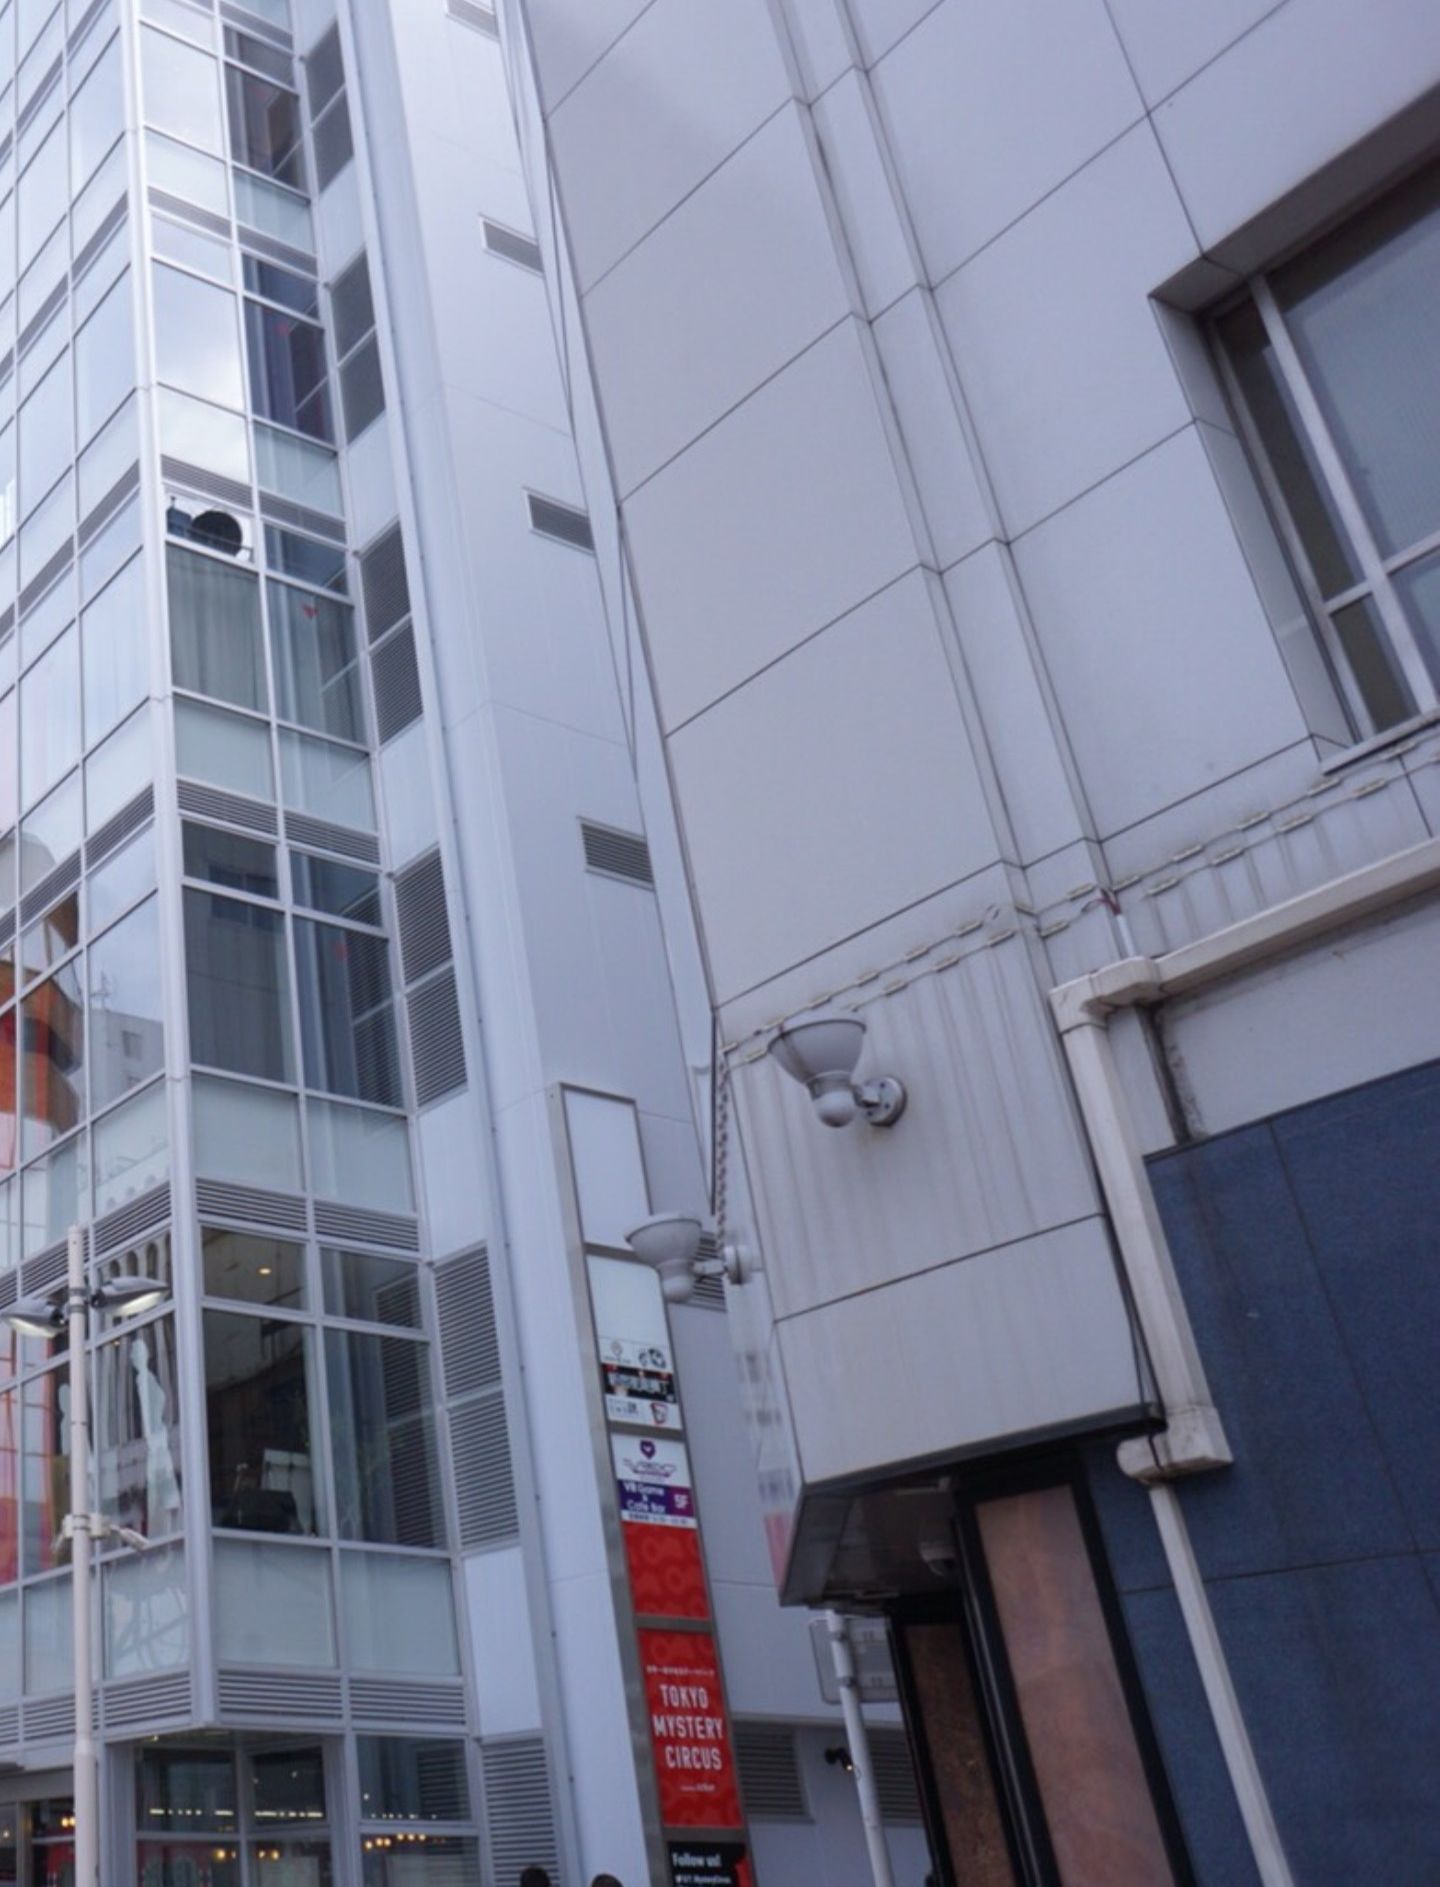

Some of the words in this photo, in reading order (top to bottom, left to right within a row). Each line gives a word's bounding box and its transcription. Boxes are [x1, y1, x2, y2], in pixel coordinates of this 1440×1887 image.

[659, 1683, 710, 1709] TOKYO
[652, 1714, 724, 1740] MYSTERY
[665, 1745, 723, 1771] CIRCUS
